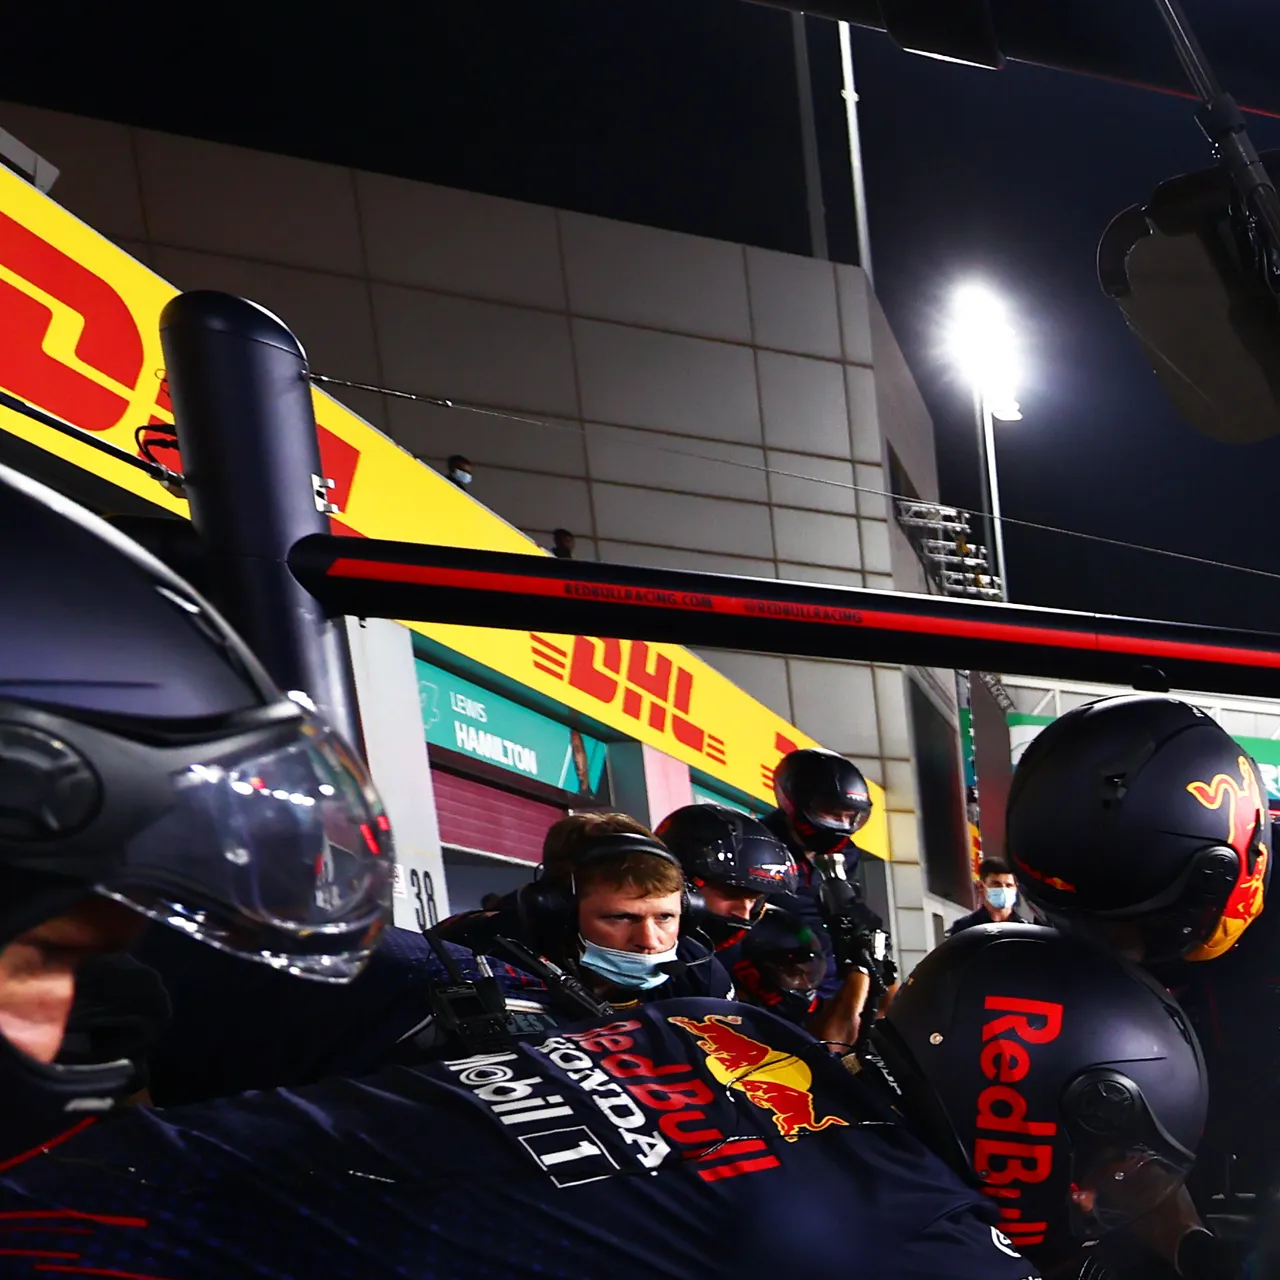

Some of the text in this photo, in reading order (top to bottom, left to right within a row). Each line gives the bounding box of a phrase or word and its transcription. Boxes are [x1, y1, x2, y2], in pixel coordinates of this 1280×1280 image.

[450, 691, 487, 723] LEWIS
[568, 635, 705, 752] DHL
[454, 721, 538, 775] HAMILTON
[410, 868, 439, 931] 38
[975, 995, 1064, 1137] Red
[628, 1081, 781, 1182] Bull
